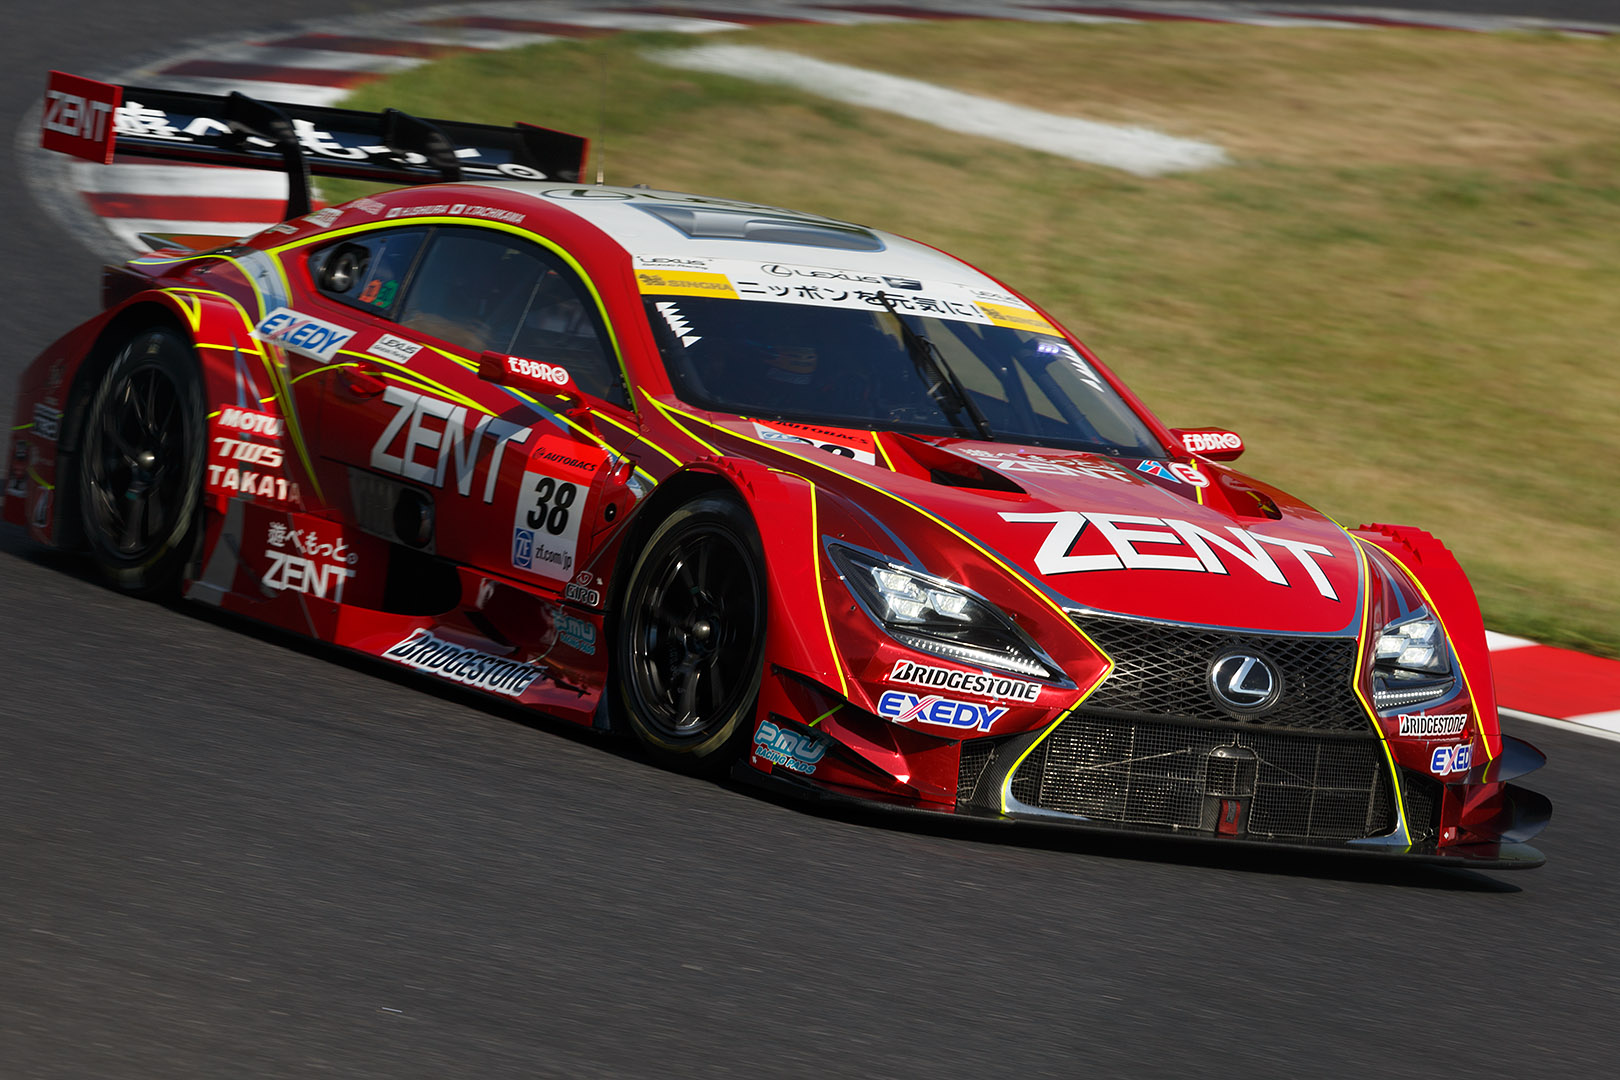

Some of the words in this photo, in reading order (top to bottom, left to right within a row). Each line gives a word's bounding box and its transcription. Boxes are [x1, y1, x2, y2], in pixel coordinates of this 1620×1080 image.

[45, 91, 112, 142] ZENT
[639, 256, 706, 266] LEXUS
[794, 269, 881, 284] LEXUS
[259, 313, 348, 354] EXEDY
[381, 336, 418, 354] LEXUS
[508, 357, 569, 385] EBBRO
[370, 385, 533, 504] ZENT
[1182, 433, 1242, 452] EBBRO
[544, 452, 598, 472] AUTOBACS
[978, 457, 1132, 483] ZENT
[208, 464, 300, 504] TAKATA
[527, 477, 577, 535] 38
[997, 511, 1342, 603] ZENT
[262, 550, 356, 603] ZENT
[388, 630, 544, 693] BRIDGESTONE
[892, 662, 1039, 700] BRIDGESTONE
[878, 692, 1004, 730] EXEDY
[1400, 715, 1466, 734] BRIDGESTONE
[755, 746, 788, 765] RACING
[785, 757, 816, 774] PADS
[1432, 745, 1473, 774] EXED
